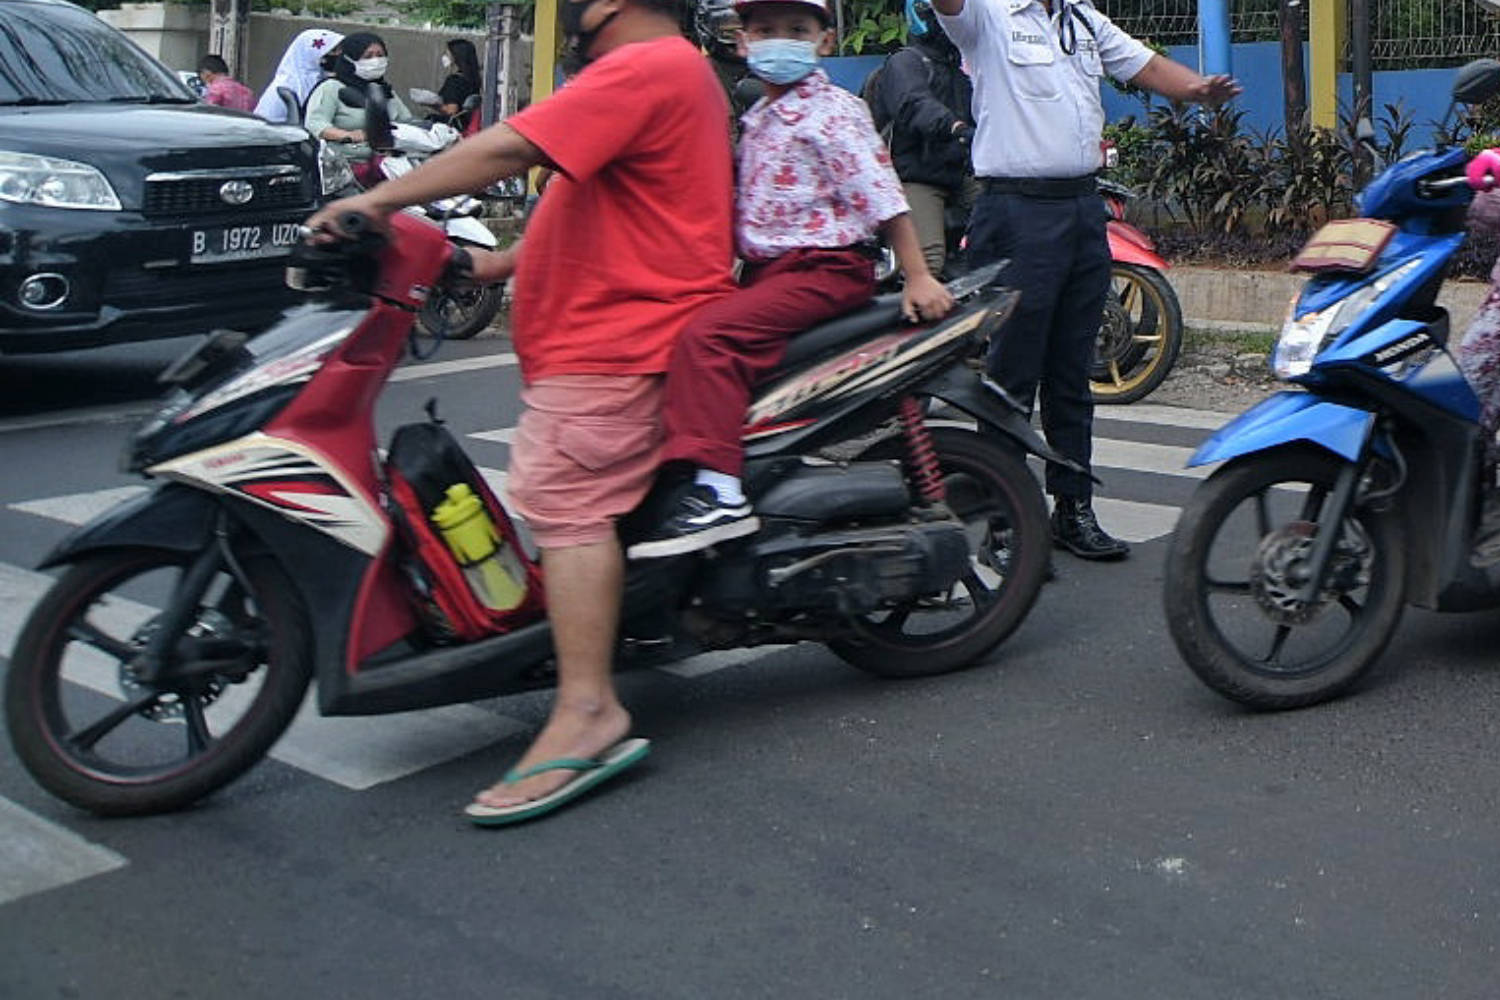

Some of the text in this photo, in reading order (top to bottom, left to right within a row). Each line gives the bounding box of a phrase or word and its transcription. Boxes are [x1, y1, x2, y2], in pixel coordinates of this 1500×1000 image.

[193, 231, 206, 254] B
[223, 226, 261, 250] 1972
[1373, 332, 1431, 362] HONDA
